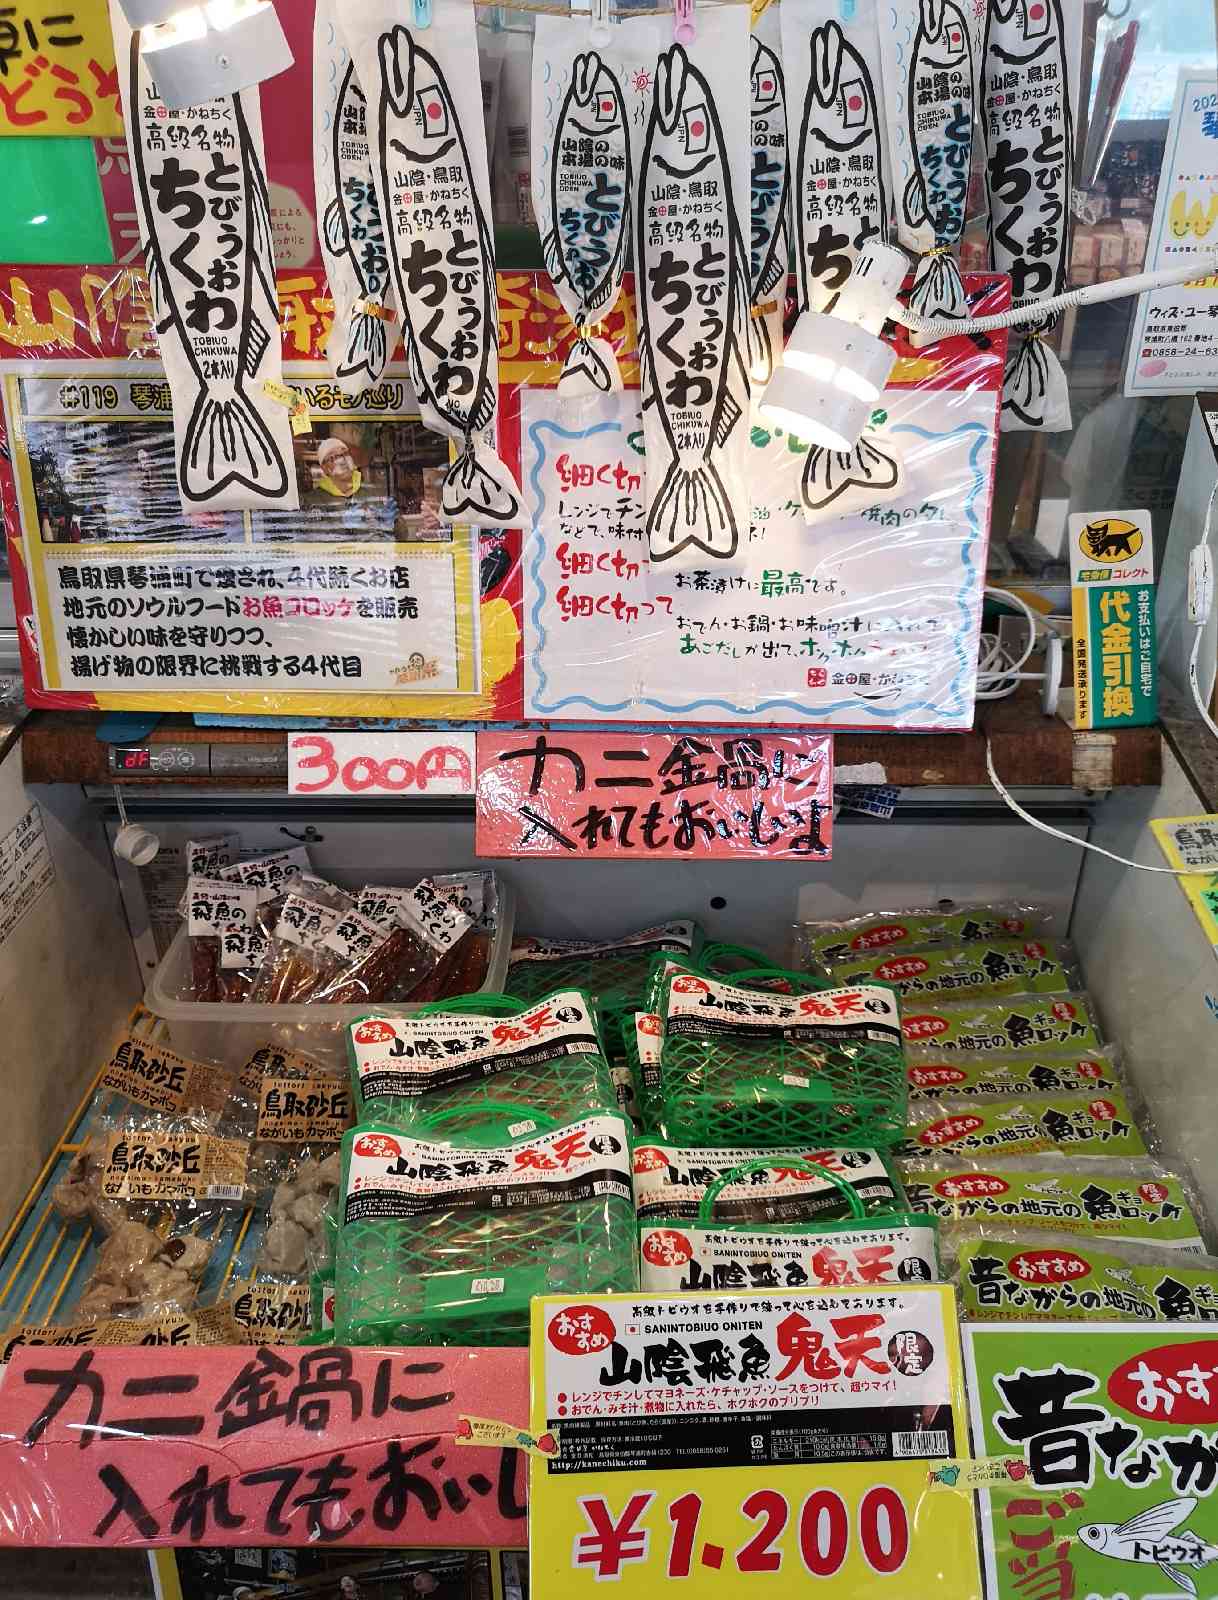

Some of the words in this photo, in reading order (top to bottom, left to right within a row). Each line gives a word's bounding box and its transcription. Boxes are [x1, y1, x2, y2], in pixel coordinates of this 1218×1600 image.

[991, 63, 1058, 92] 山陰・鳥取
[988, 103, 1061, 136] 高級名物
[145, 124, 236, 152] 高級名物
[394, 166, 464, 189] 山陰・鳥取
[810, 155, 875, 176] 山陰・鳥取
[651, 180, 719, 202] 山陰・鳥取
[397, 204, 474, 236] 高級名物
[806, 191, 879, 222] 高級名物
[988, 140, 1052, 295] ちくわ
[149, 156, 239, 333] ちくわ
[648, 218, 725, 247] 高級名物
[402, 239, 475, 395] ちくわ
[649, 250, 713, 410] ちくわ
[193, 336, 228, 346] TOBIUO
[193, 346, 238, 357] CHIKUWA
[202, 360, 235, 380] 2本入り
[58, 384, 119, 410] #119
[671, 411, 702, 421] TOBIUO
[671, 420, 710, 430] CHIKUWA
[677, 431, 706, 450] 2本入り
[555, 453, 646, 494] 細く切
[555, 542, 650, 579] 細く切
[1112, 567, 1150, 580] コレクト
[62, 594, 419, 620] 地元のソウルフードお魚コロッケを販売
[555, 585, 673, 623] 細く切って
[67, 625, 274, 649] 懐かしい味を守りつつ、
[1136, 590, 1152, 697] お支払いはご自宅で
[70, 654, 363, 679] 揚げ物の限界に挑戦する4代目
[1099, 590, 1135, 719] 代金引換
[191, 899, 248, 921] 飛魚の
[878, 956, 930, 981] おすすめ
[799, 992, 866, 1018] 鬼天
[109, 1040, 187, 1095] 鳥取砂丘
[910, 1066, 964, 1085] おすすめ
[261, 1087, 349, 1120] 鳥取砂丘
[923, 1116, 980, 1145] おすすめ
[106, 1141, 202, 1175] 鳥取砂丘
[358, 1134, 398, 1157] おすすめ
[942, 1176, 1005, 1197] おすすめ
[1116, 1190, 1143, 1205] ギョ
[648, 1234, 689, 1265] おすすめ
[712, 1249, 770, 1259] SANINTOBIUO
[771, 1250, 802, 1258] ONITEN
[811, 1244, 897, 1287] 鬼天
[1014, 1254, 1086, 1280] おすすめ
[968, 1256, 1158, 1320] 昔ながらの地元の
[555, 1311, 609, 1351] おすすめ
[644, 1322, 720, 1335] SANINTOBIUO
[721, 1320, 764, 1332] ONITEN
[599, 1332, 772, 1387] 山陰飛魚
[775, 1311, 892, 1382] 鬼天
[894, 1333, 925, 1376] 限定
[23, 1346, 457, 1450] カニ鍋に
[1127, 1360, 1218, 1417] おす
[1133, 1540, 1206, 1563] トビウオ
